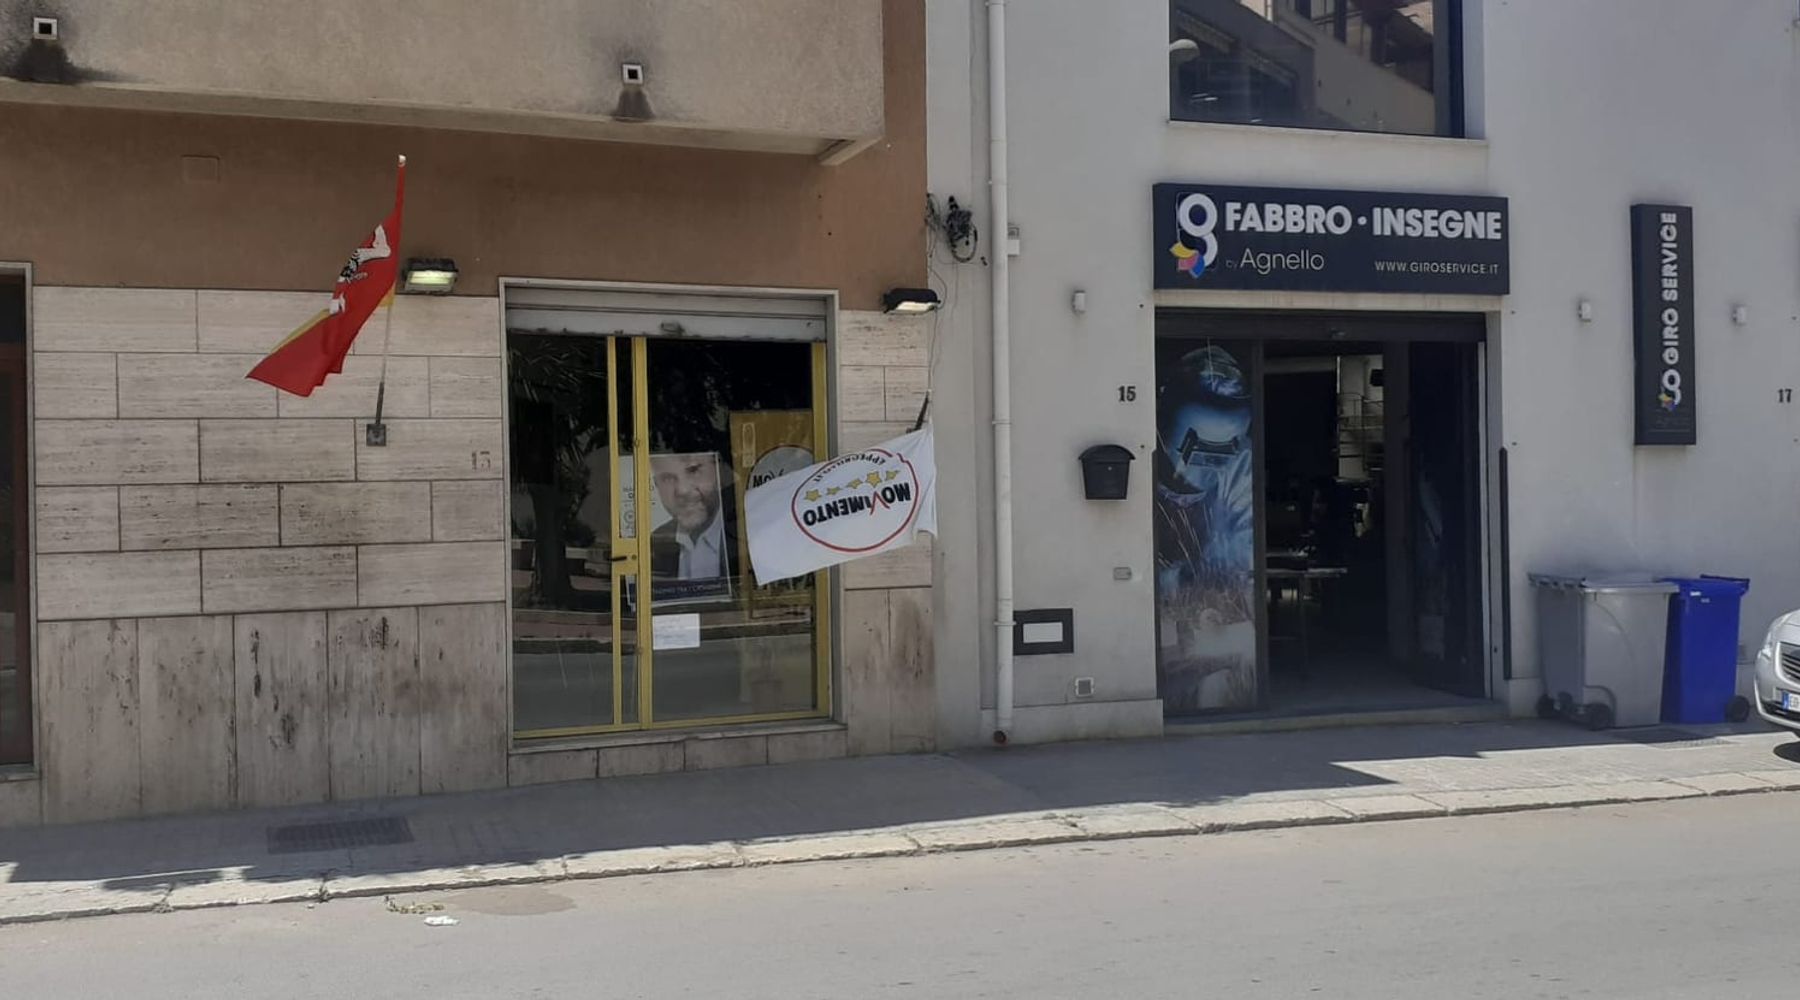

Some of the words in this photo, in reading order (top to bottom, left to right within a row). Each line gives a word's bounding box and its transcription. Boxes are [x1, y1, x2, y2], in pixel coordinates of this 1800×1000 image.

[1225, 201, 1354, 236] FABBRO
[1372, 206, 1503, 240] INSEGNE
[1239, 247, 1326, 275] Agnello
[1660, 212, 1679, 302] SERVICE
[1661, 306, 1680, 366] GIRO
[1118, 386, 1136, 402] 15
[1778, 388, 1793, 404] 17
[802, 482, 912, 527] MOVIMENTO
